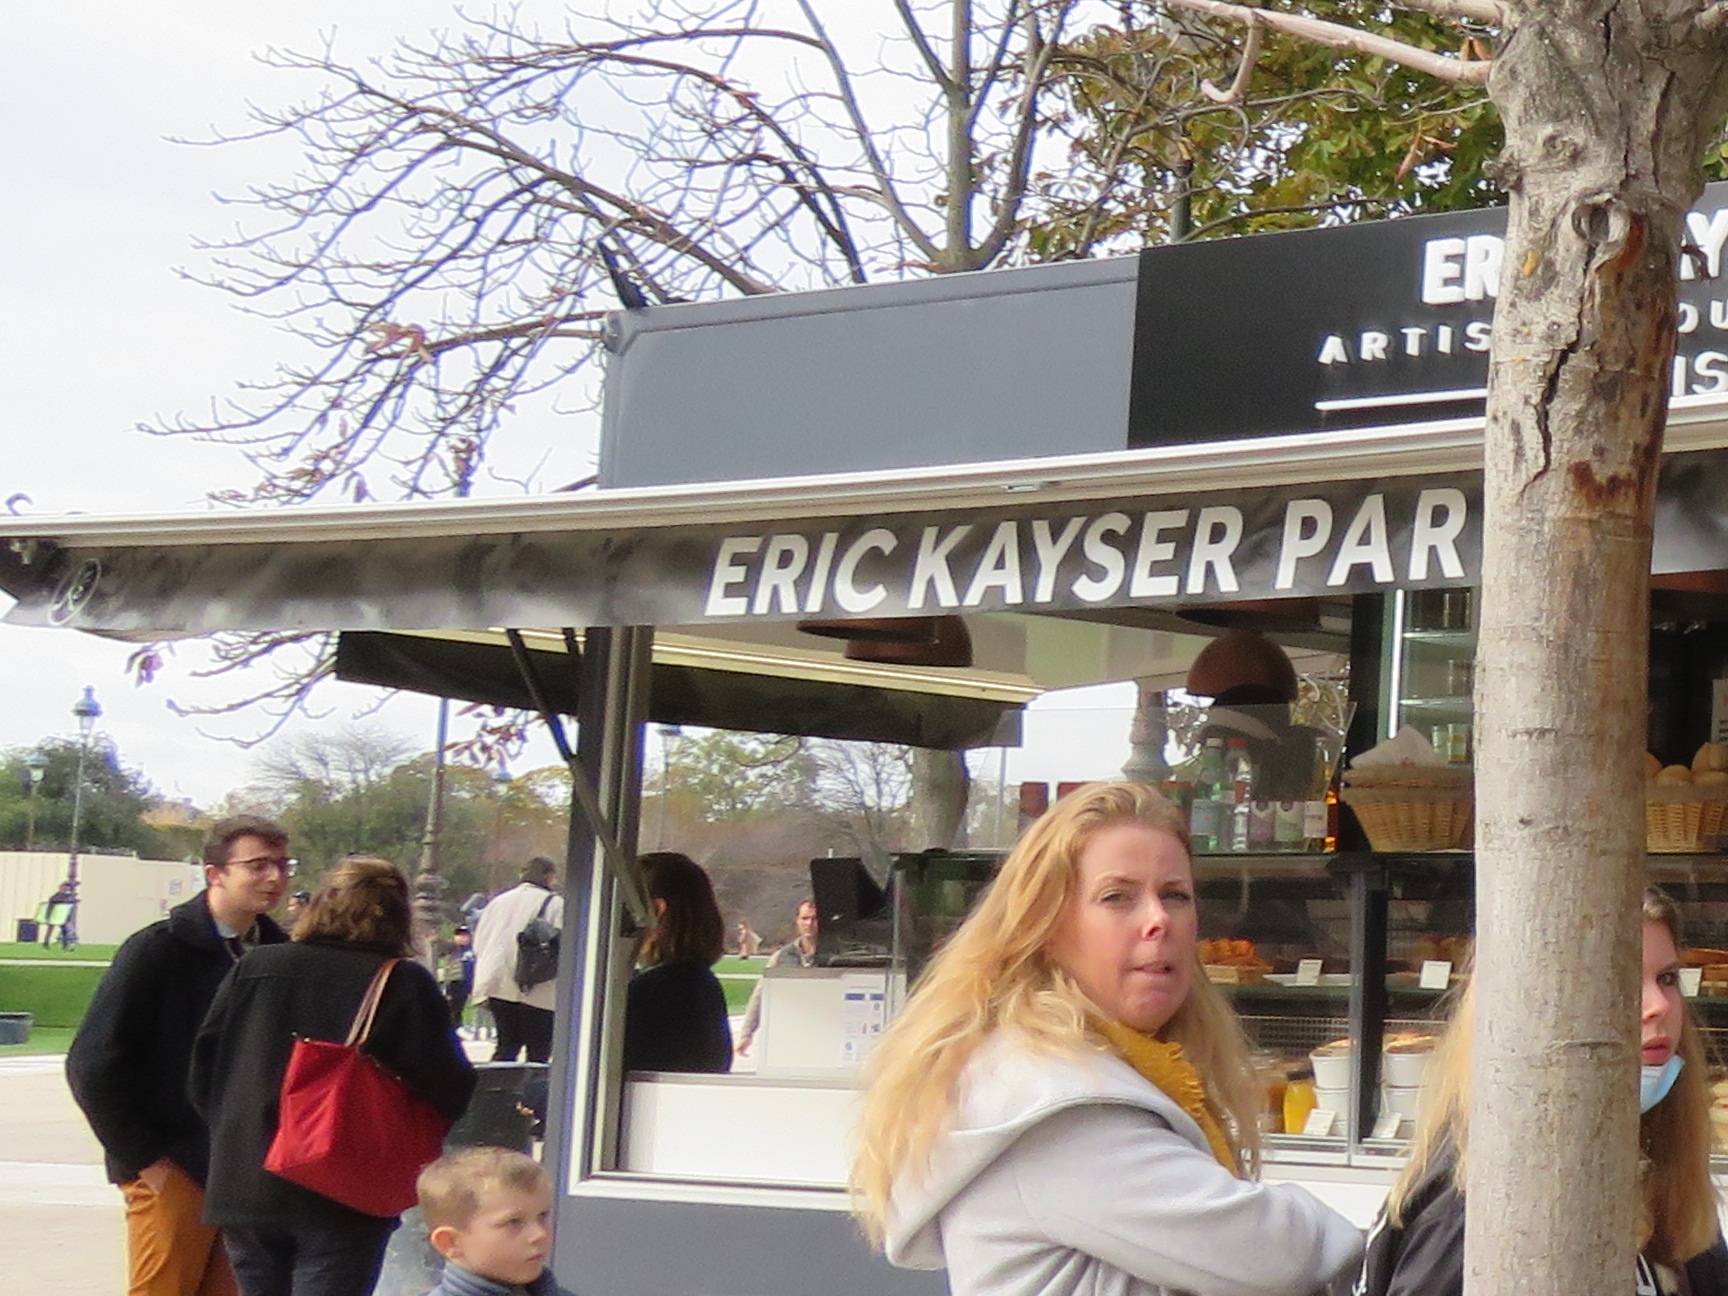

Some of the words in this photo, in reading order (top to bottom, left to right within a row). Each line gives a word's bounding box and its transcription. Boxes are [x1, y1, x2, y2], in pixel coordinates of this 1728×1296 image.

[1422, 234, 1505, 304] ER
[1317, 321, 1492, 366] ARTIS
[704, 527, 897, 618] ERIC
[906, 504, 1244, 610] KAYSER
[1274, 487, 1466, 592] PAR
